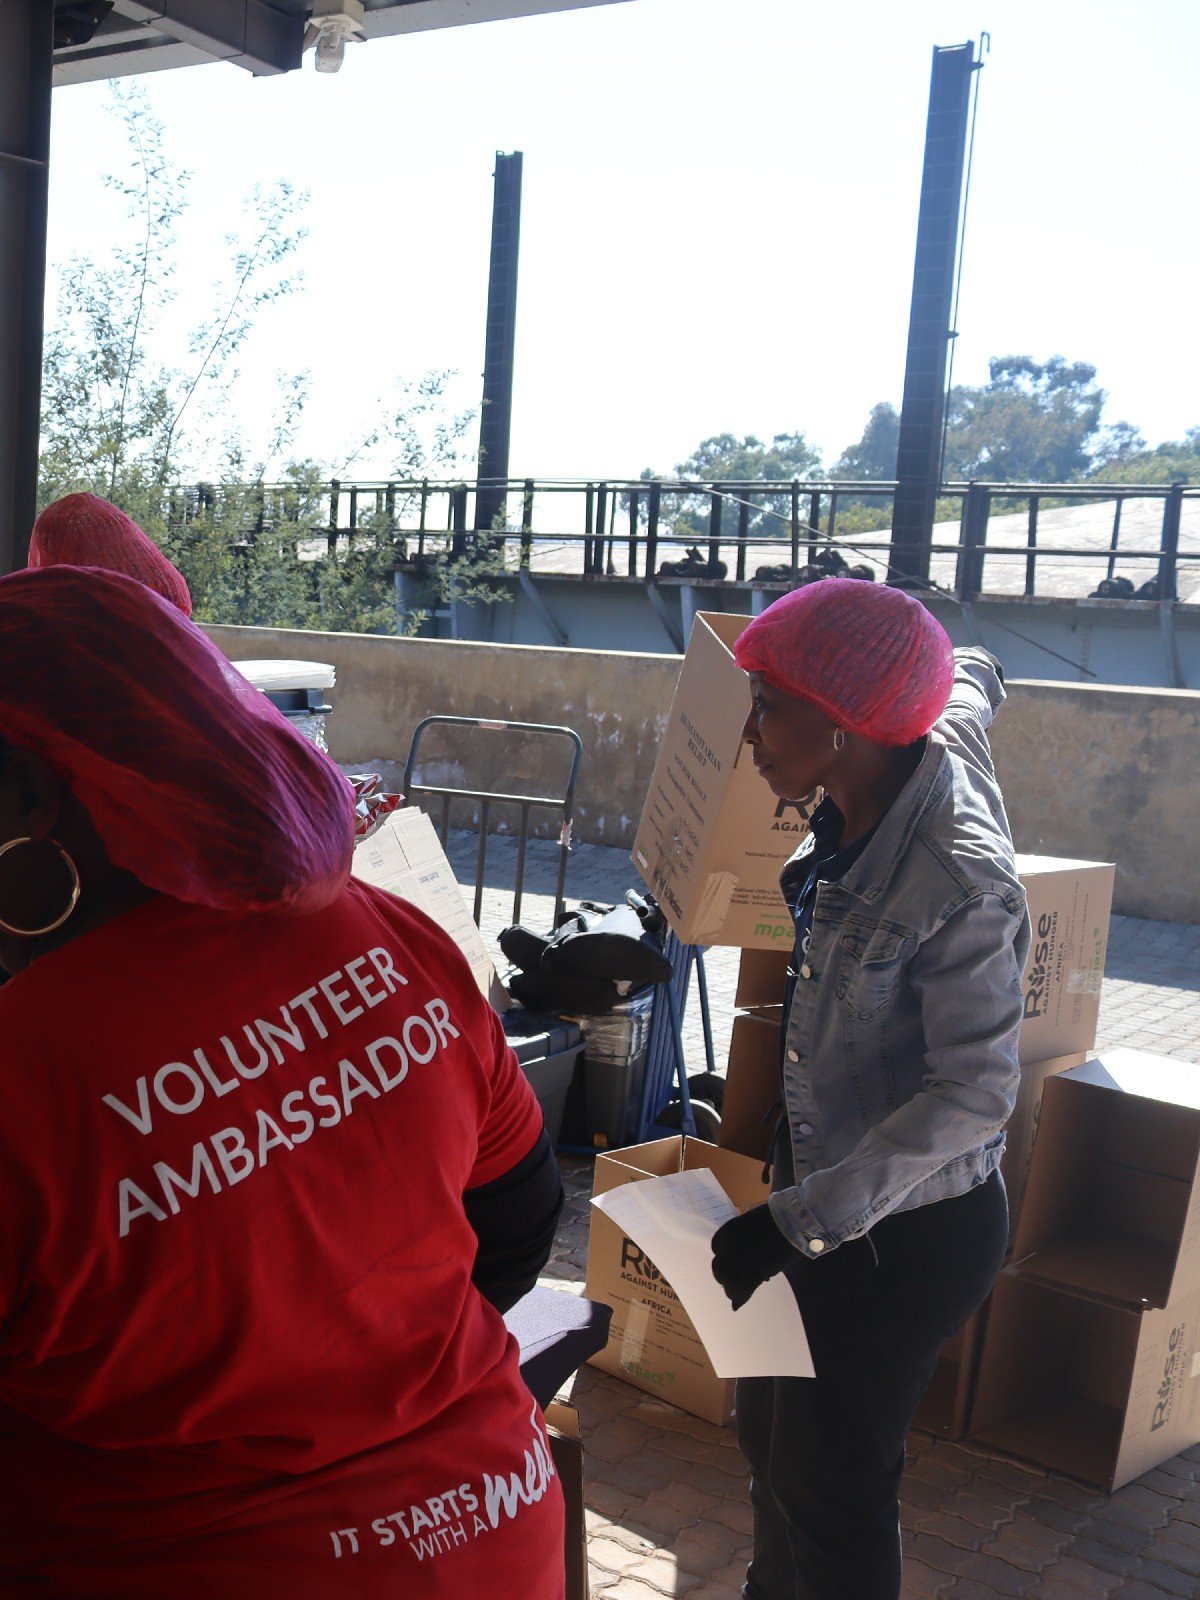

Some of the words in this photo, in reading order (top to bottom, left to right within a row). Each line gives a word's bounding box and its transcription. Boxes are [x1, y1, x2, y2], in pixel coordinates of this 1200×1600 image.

[102, 947, 408, 1135] VOLUNTEER
[119, 998, 460, 1237] AMBASSADOR
[621, 1271, 658, 1292] AGAINST
[641, 1297, 673, 1317] AFRICA
[329, 1528, 359, 1558] IT
[371, 1483, 479, 1546] STARTS
[409, 1522, 468, 1561] WITH
[473, 1514, 489, 1538] A
